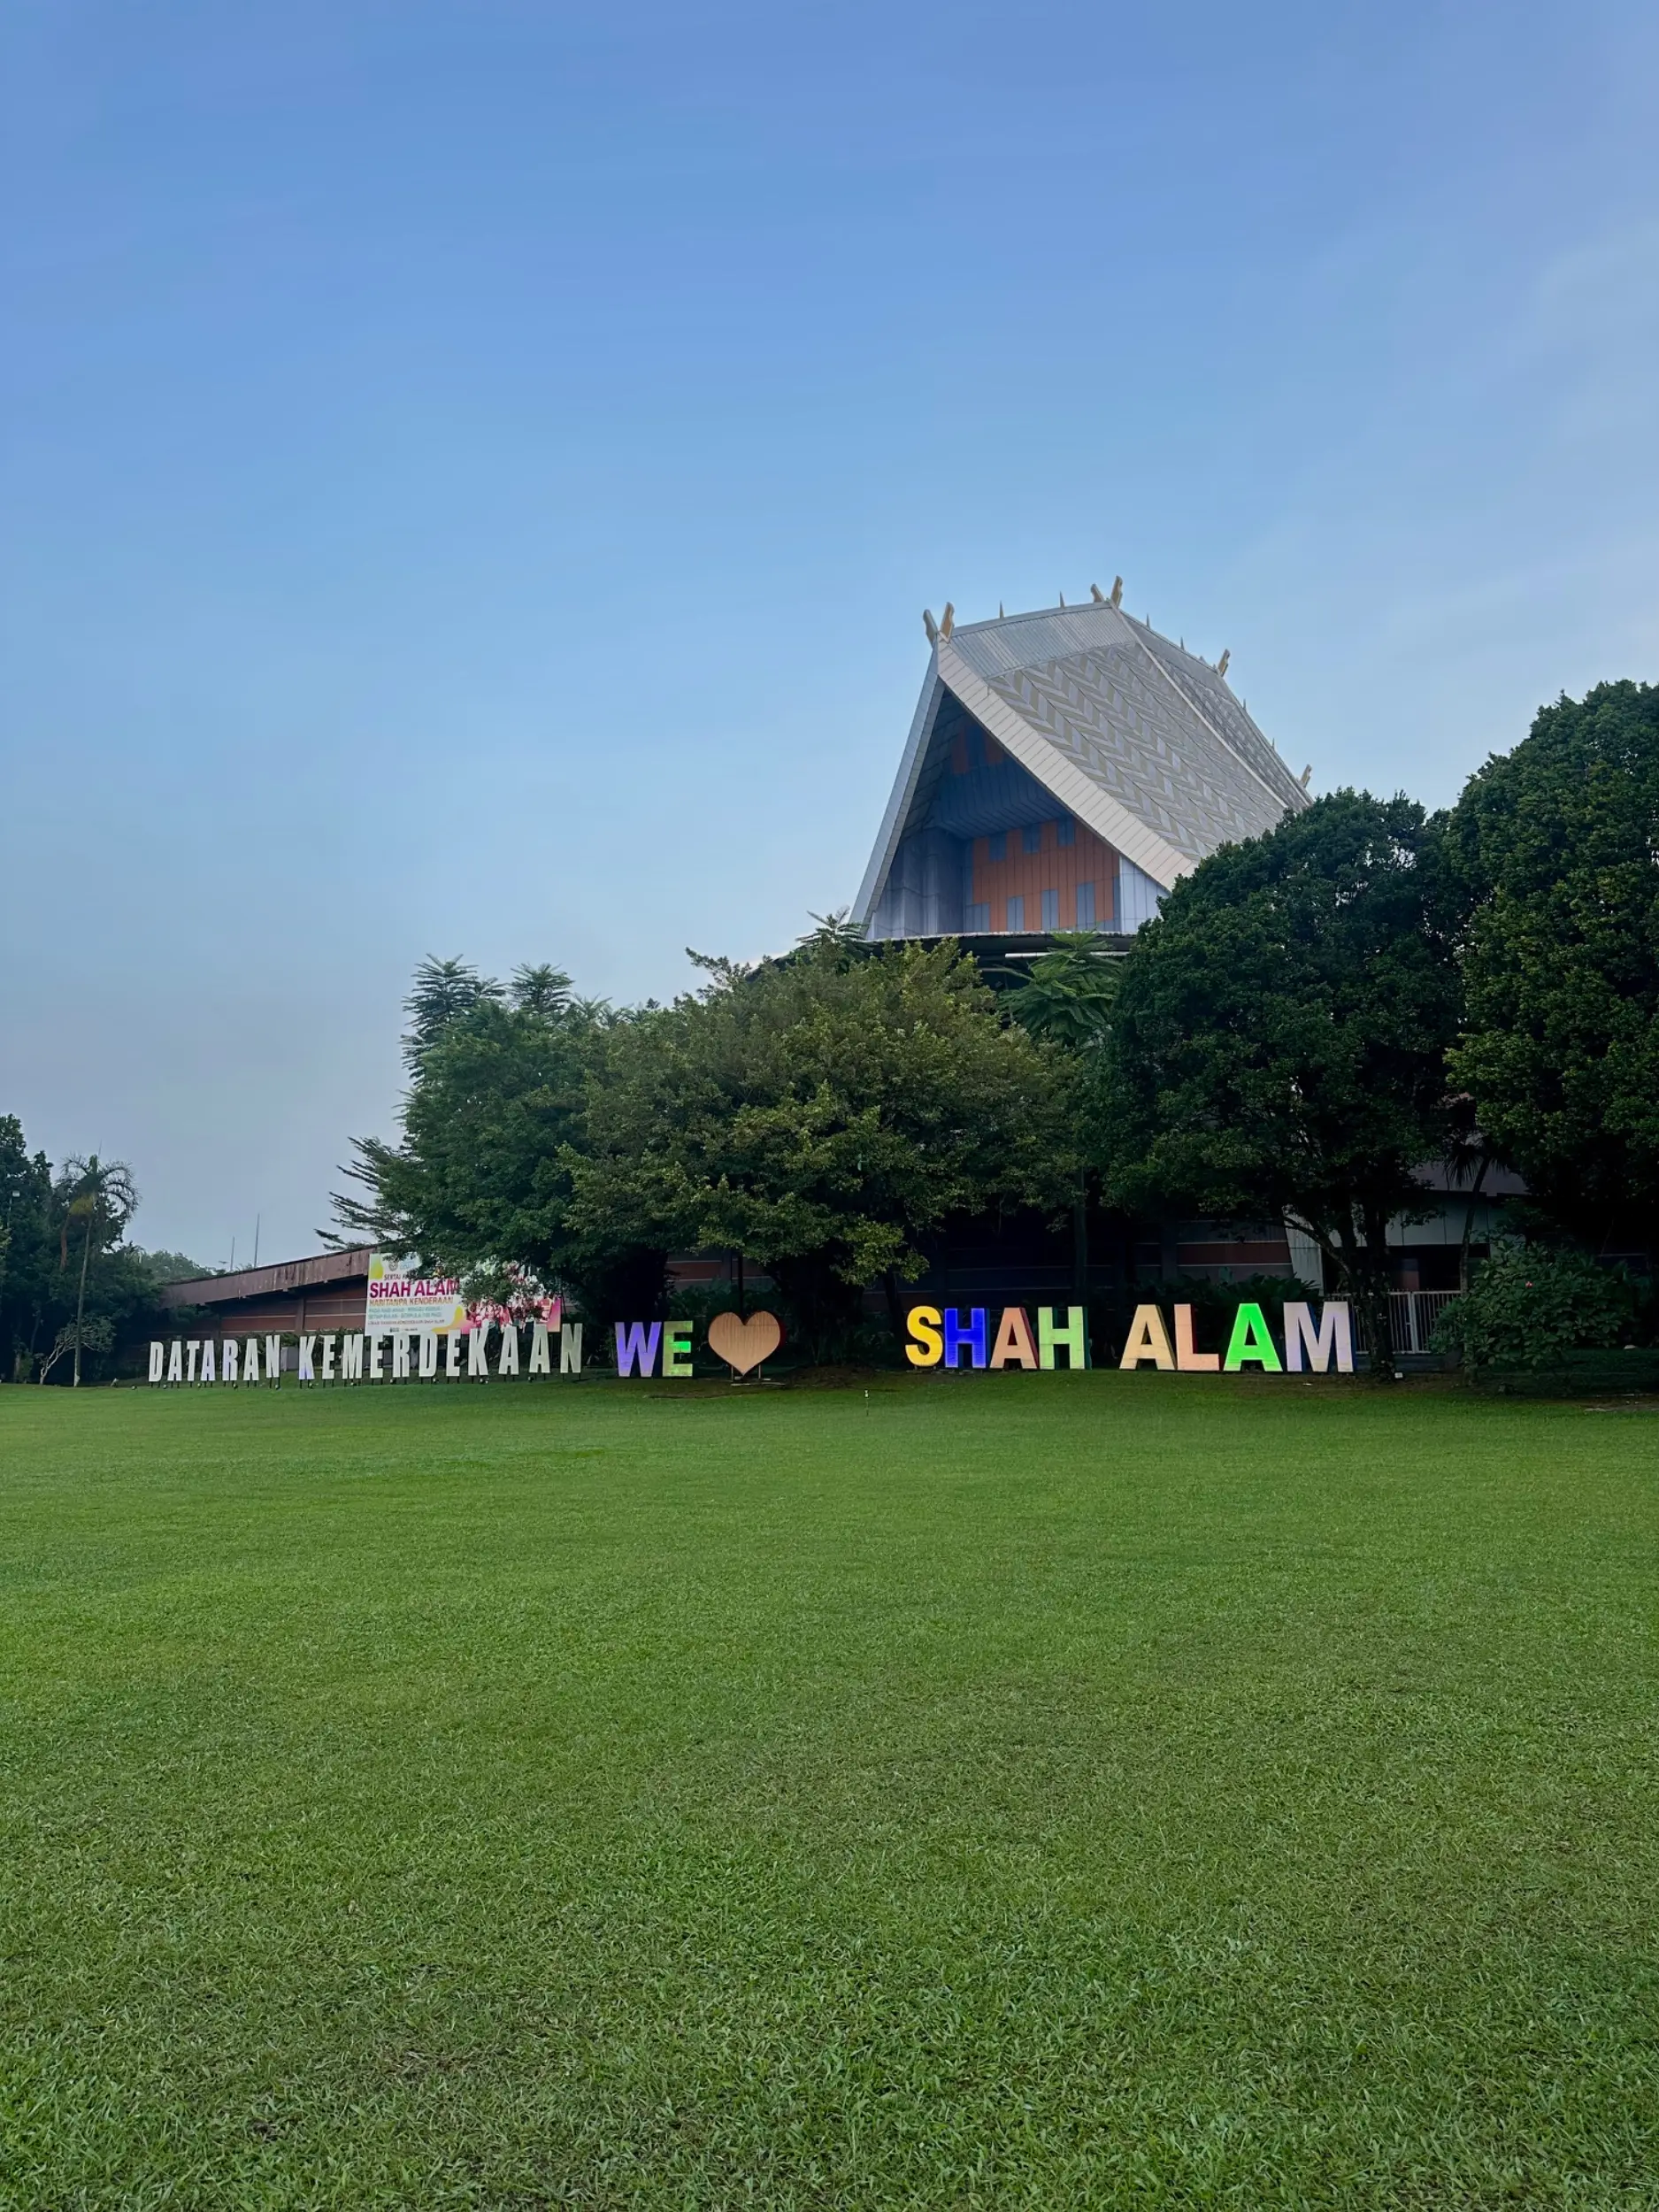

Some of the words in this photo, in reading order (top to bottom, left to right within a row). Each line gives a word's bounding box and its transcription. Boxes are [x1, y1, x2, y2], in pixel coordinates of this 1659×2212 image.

[370, 1280, 411, 1298] SHAH
[410, 1296, 453, 1305] KENDERAAN
[149, 1334, 280, 1382] DATARAN
[299, 1323, 583, 1381] KEMERDEKAAN
[614, 1320, 693, 1378] WE
[904, 1305, 1087, 1370] SHAH
[1119, 1302, 1356, 1372] ALAM
